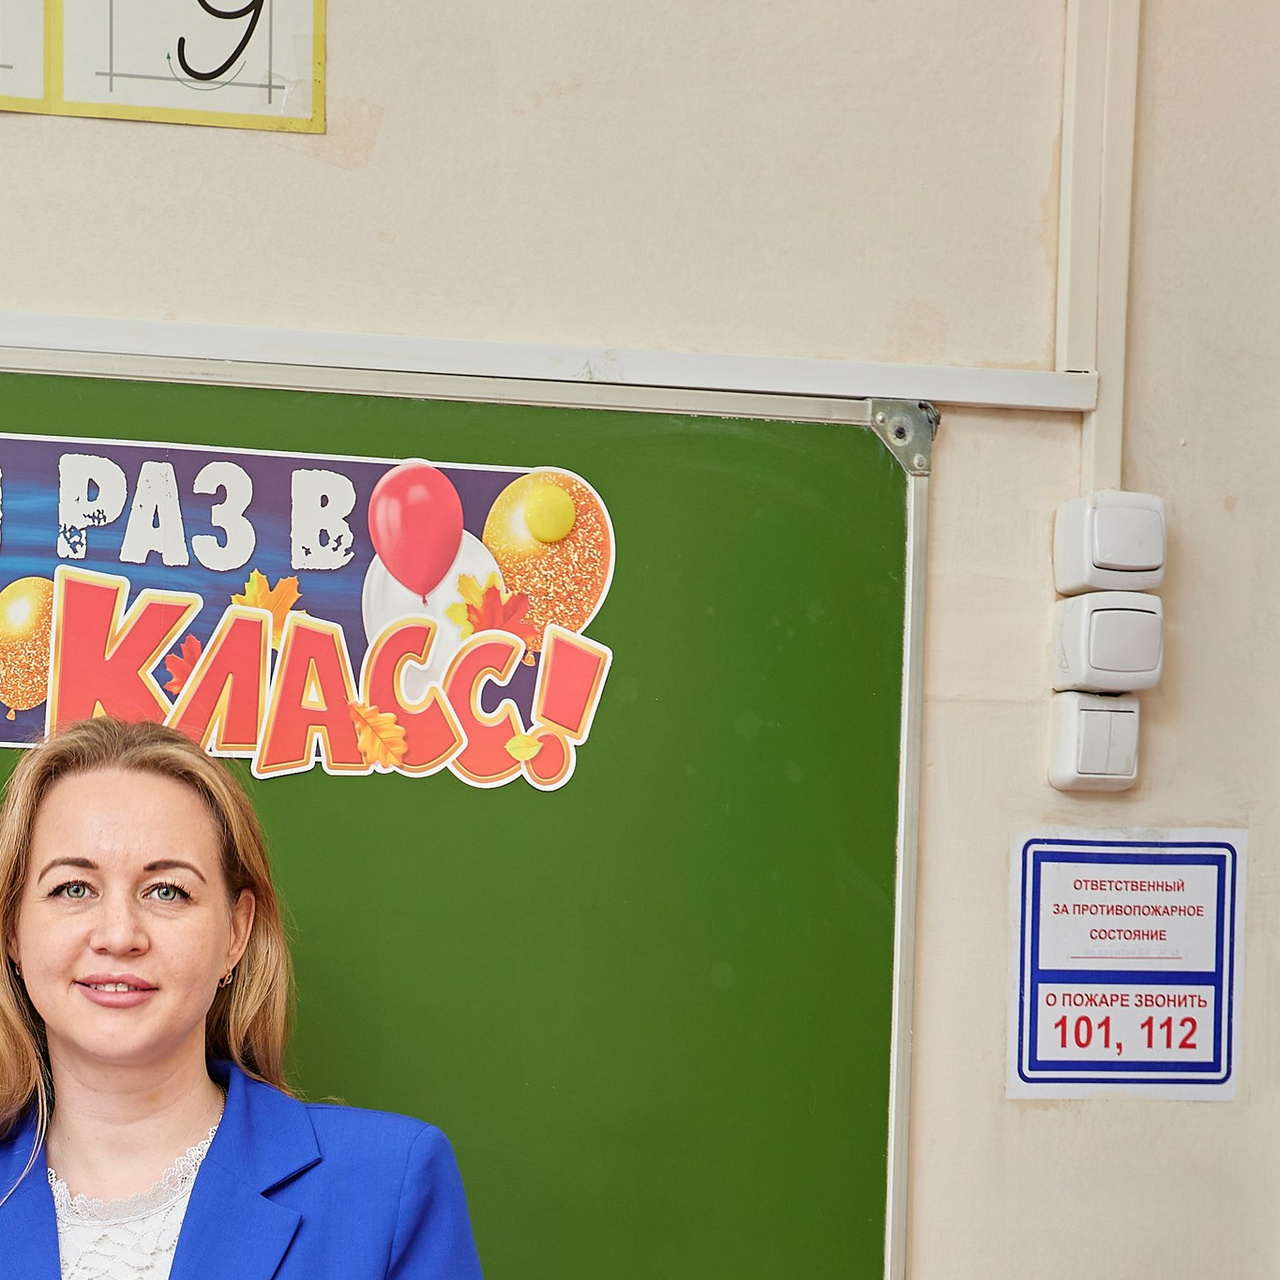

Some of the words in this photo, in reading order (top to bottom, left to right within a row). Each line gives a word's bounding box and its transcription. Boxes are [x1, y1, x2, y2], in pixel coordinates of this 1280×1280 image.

[56, 453, 258, 572] РАЗ
[289, 468, 357, 571] В
[53, 566, 610, 788] КЛАСС!
[1072, 878, 1186, 893] ОТВЕТСТВЕННЫЙ
[1052, 903, 1070, 916] ЗА
[1072, 903, 1205, 917] ПРОТИВОПОЖАРНОЕ
[1089, 928, 1168, 941] СОСТОЯНИЕ
[1045, 992, 1058, 1007] О
[1061, 993, 1130, 1008] ПОЖАРЕ
[1134, 993, 1208, 1008] ЗВОНИТЬ
[1053, 1014, 1123, 1057] 101,
[1140, 1015, 1198, 1050] 112
